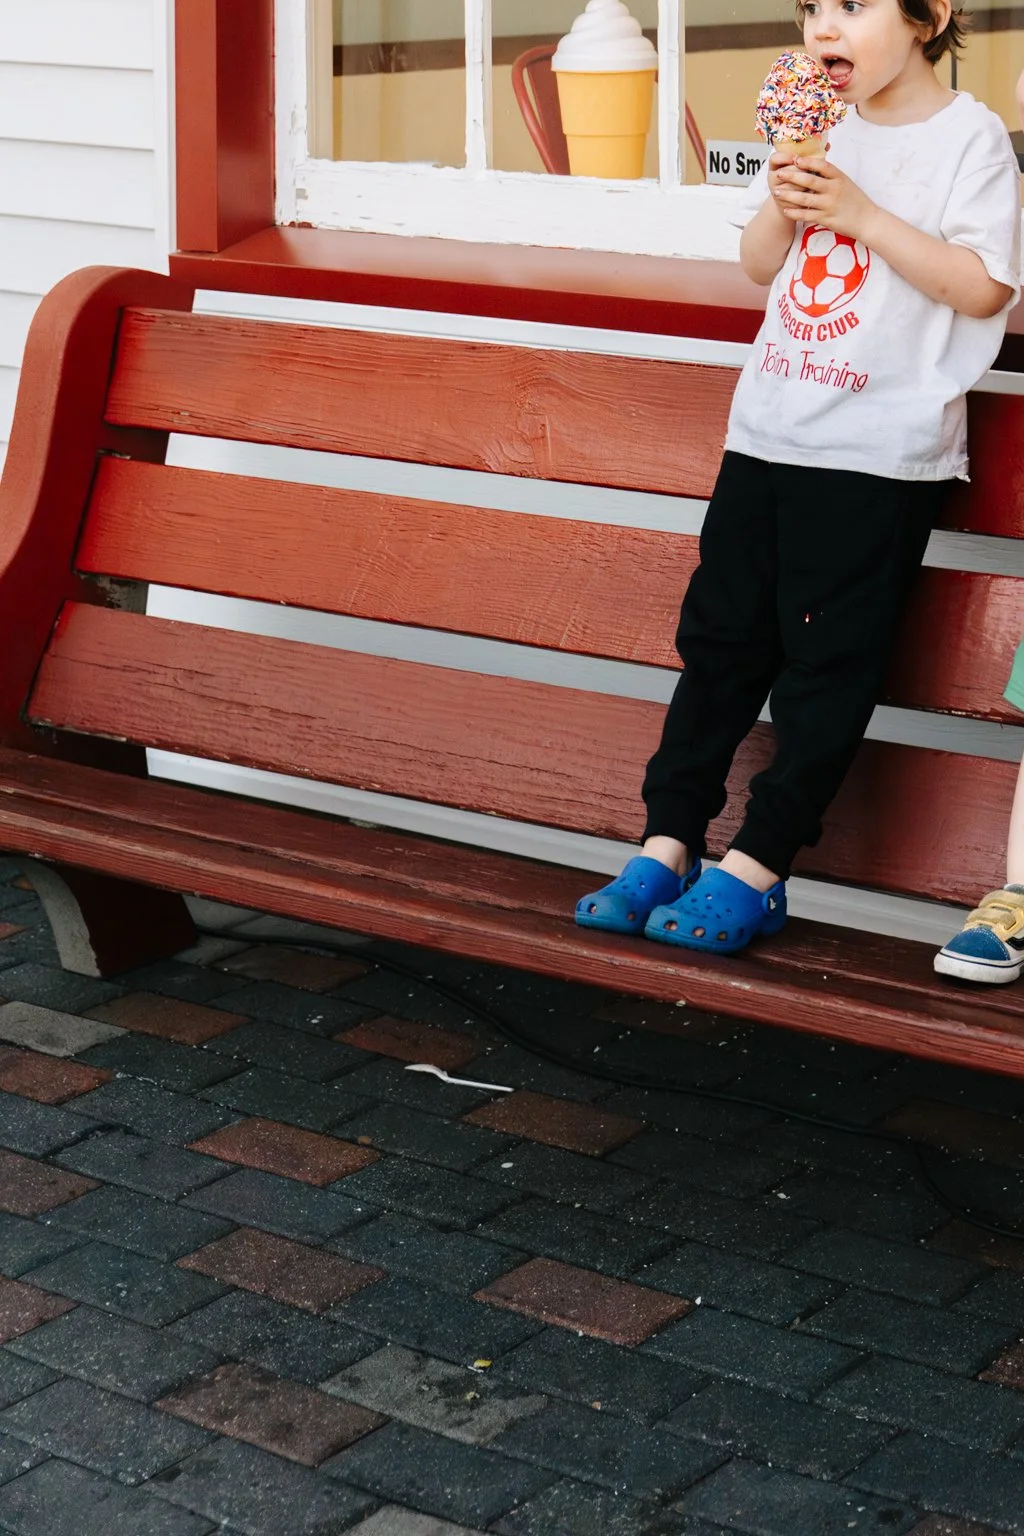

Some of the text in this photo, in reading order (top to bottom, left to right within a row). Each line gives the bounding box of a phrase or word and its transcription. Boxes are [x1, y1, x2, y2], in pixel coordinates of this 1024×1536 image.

[709, 151, 766, 175] No Sm
[777, 293, 860, 342] SOCCER CLUB
[799, 351, 868, 393] Training
